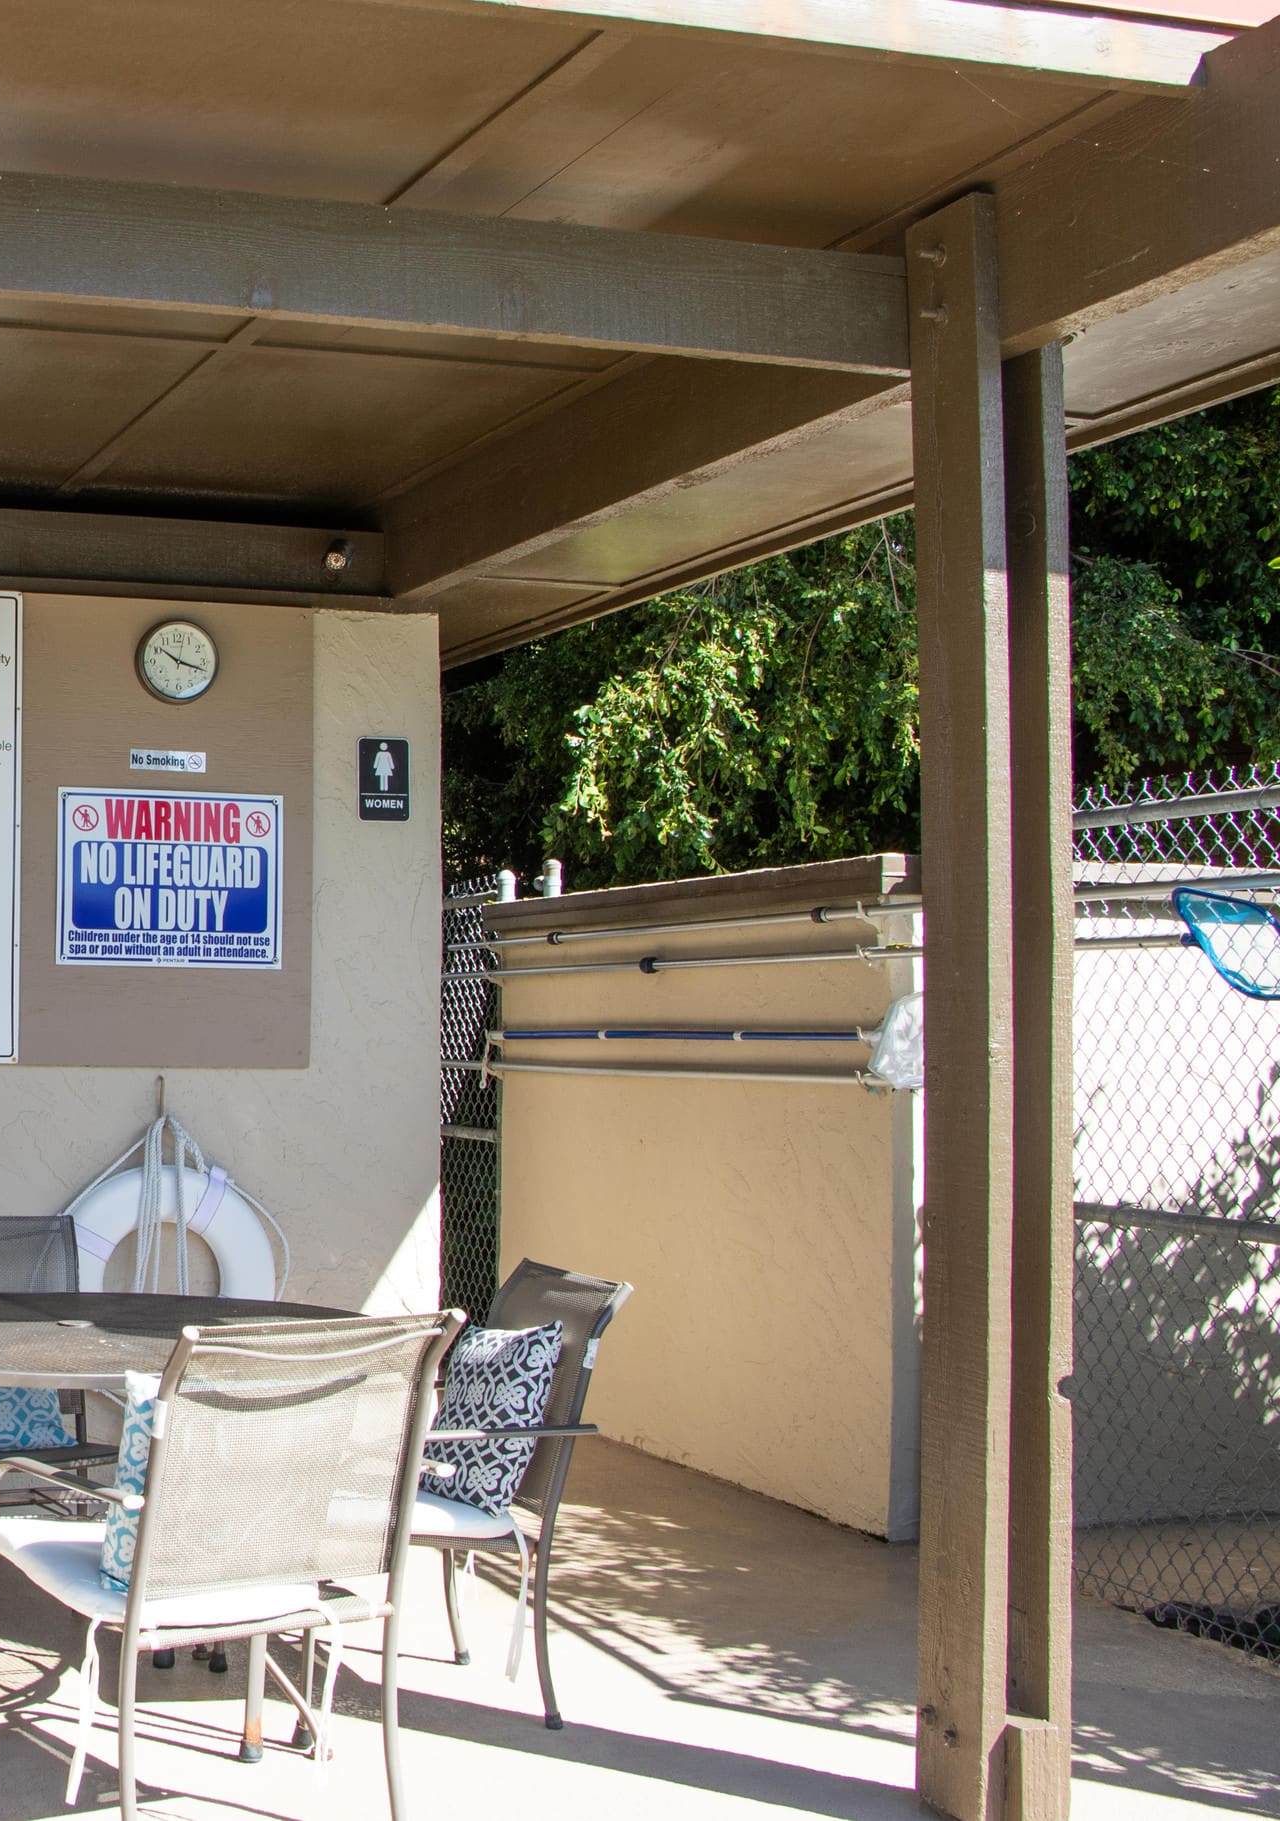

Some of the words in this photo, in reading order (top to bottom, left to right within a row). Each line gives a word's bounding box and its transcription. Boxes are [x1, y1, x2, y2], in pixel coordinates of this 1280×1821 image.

[162, 637, 168, 645] 11
[173, 633, 182, 643] 12
[195, 645, 200, 653] 2
[132, 754, 144, 764] No
[146, 755, 185, 769] Smoking
[365, 799, 403, 808] WOMEN
[105, 799, 240, 844] WARNING
[81, 842, 116, 885] NO
[124, 844, 260, 889] LIFEGUARD
[115, 887, 151, 930] ON
[159, 888, 228, 931] DUTY
[68, 930, 109, 942] Children
[111, 931, 140, 943] under
[142, 932, 157, 944] the
[159, 935, 177, 947] age
[179, 933, 188, 944] of
[190, 933, 200, 945] 14
[202, 933, 234, 946] should
[236, 934, 251, 946] not
[253, 937, 270, 946] use
[69, 945, 86, 957] spa
[88, 946, 99, 954] or
[101, 944, 122, 958] pool
[124, 944, 160, 956] without
[162, 948, 174, 956] an
[176, 945, 200, 957] adult
[202, 946, 211, 957] in
[213, 946, 268, 958] attendance.
